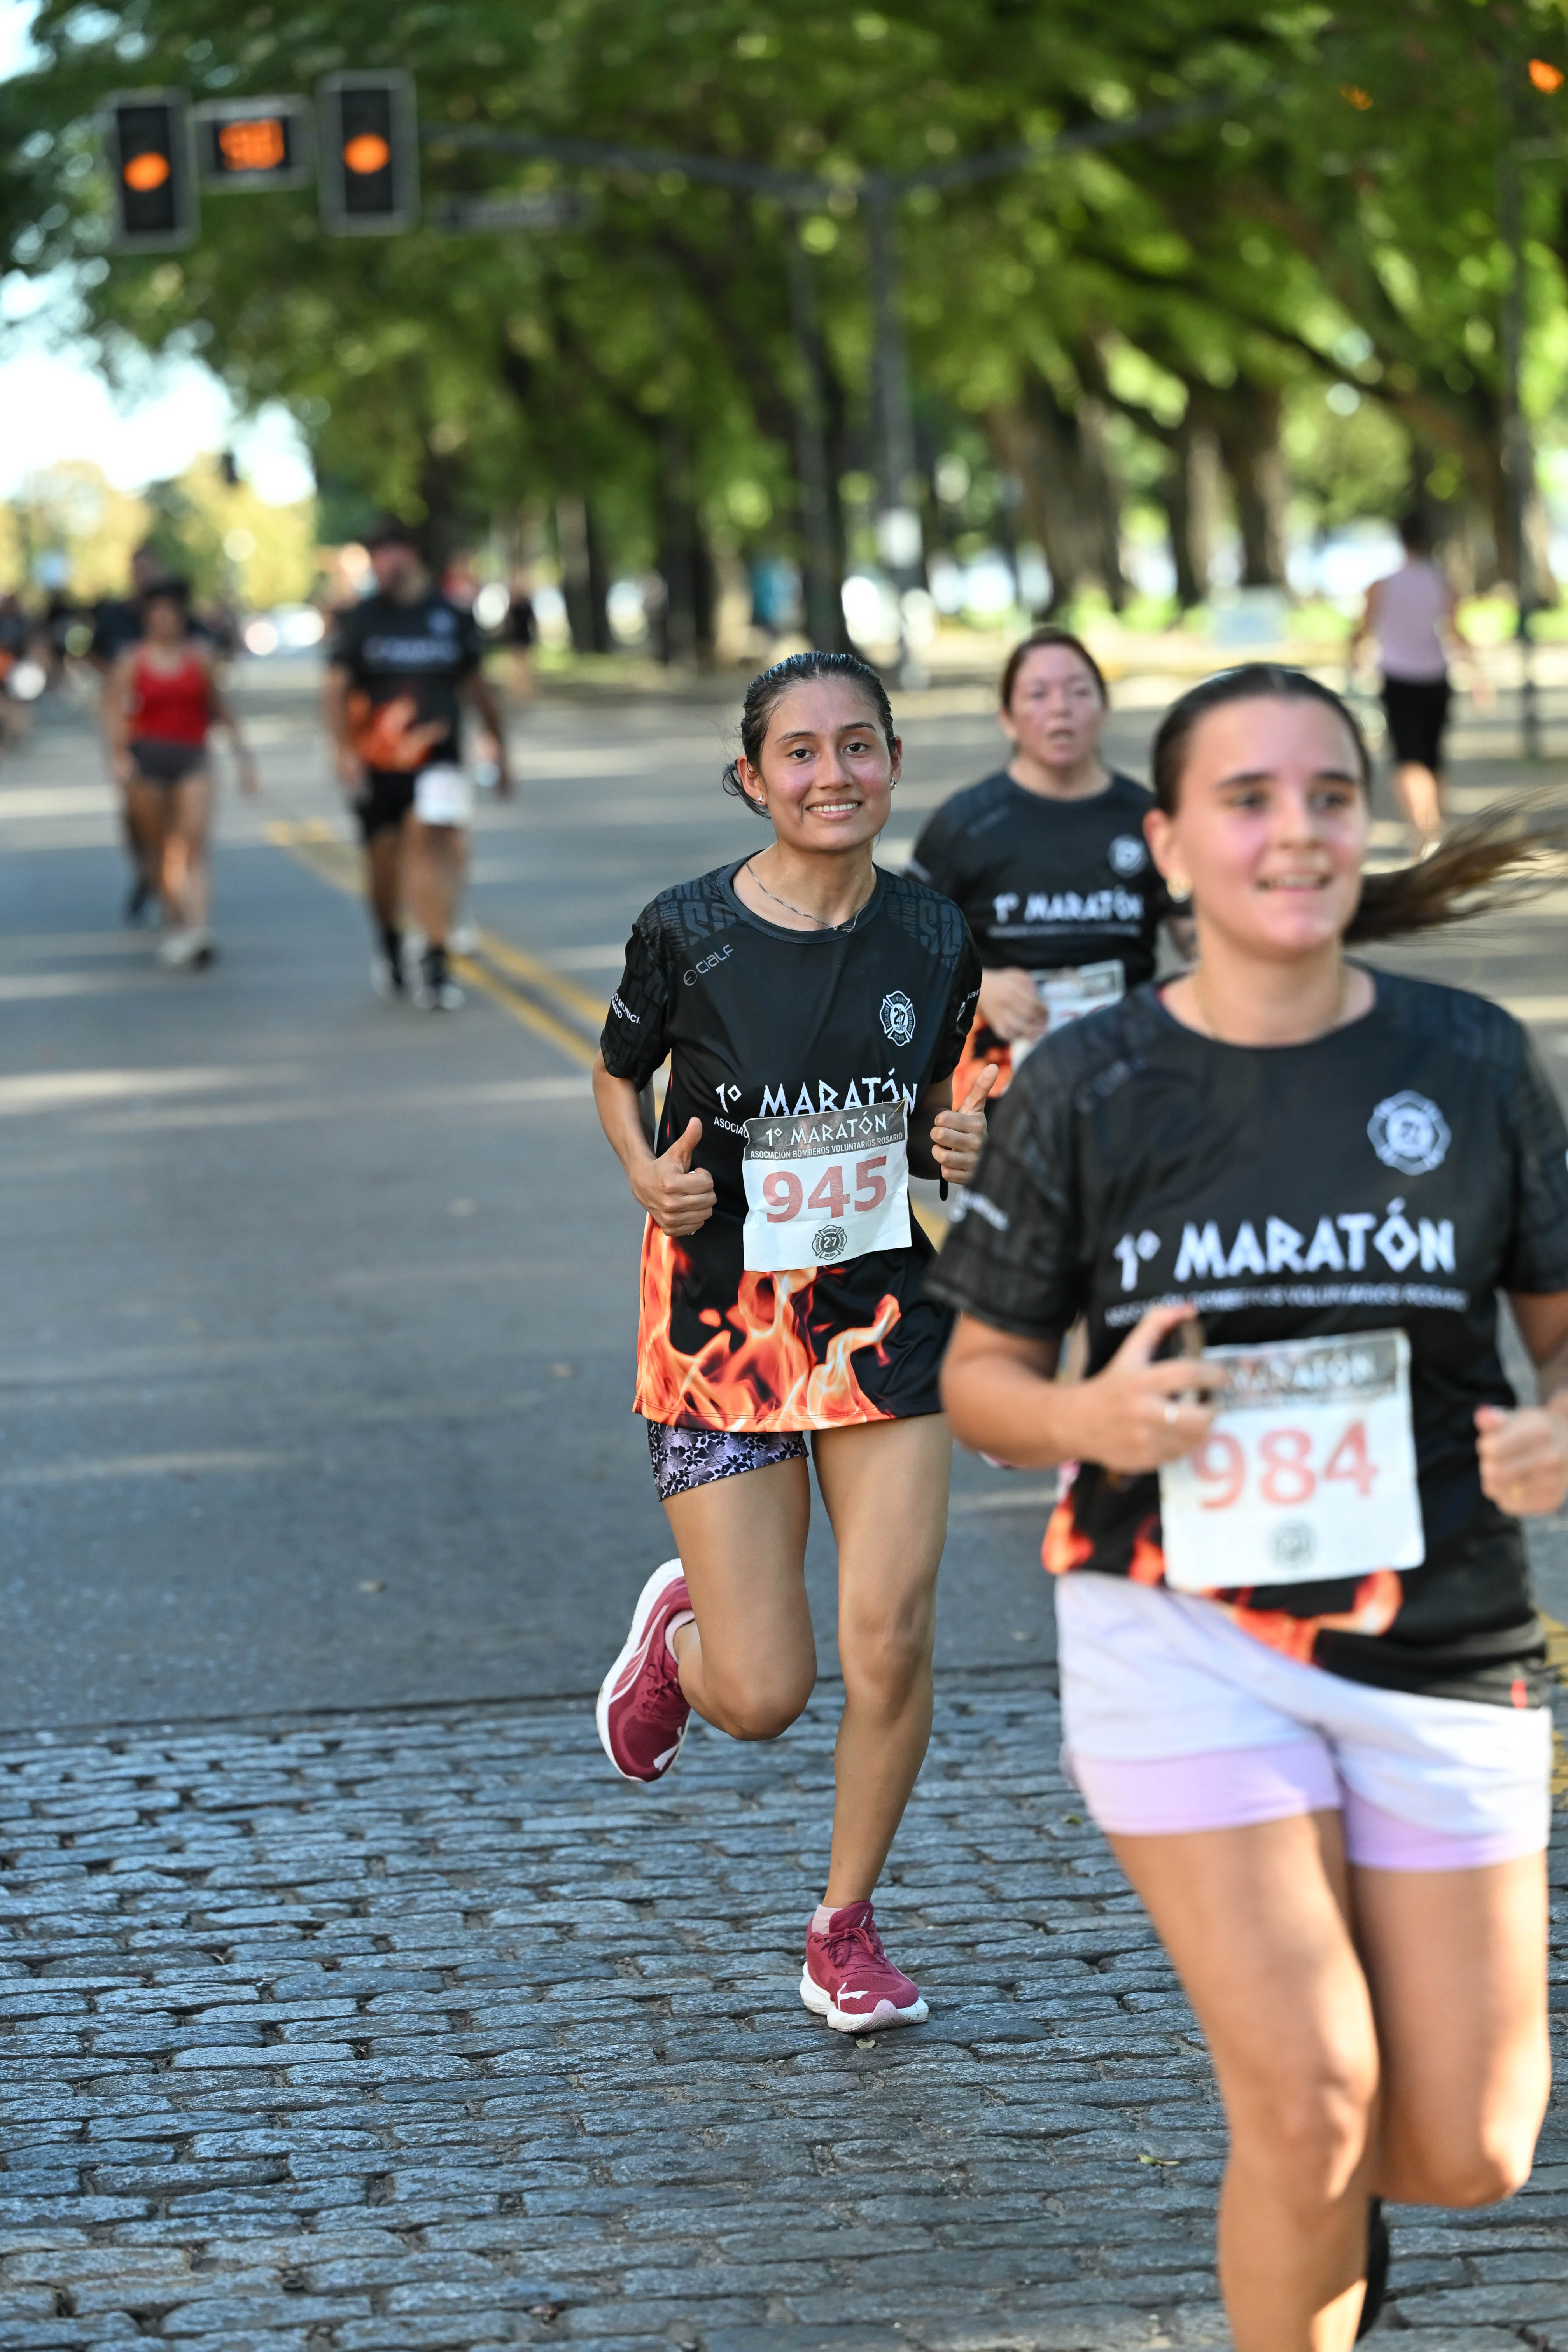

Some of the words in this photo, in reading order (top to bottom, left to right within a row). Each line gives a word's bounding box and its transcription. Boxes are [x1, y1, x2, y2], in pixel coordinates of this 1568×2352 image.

[1024, 884, 1145, 923] MARATÓN
[618, 999, 640, 1024] MUNICI
[759, 1068, 918, 1117] MARATÓN
[750, 1150, 791, 1159] ASOCIACIÓN
[793, 1145, 830, 1157] BOMBEROS
[831, 1141, 876, 1153] VOLUNTARIOS
[877, 1132, 903, 1145] ROSARIO
[790, 1111, 887, 1146] MARATÓN
[763, 1155, 887, 1223] 945
[824, 1237, 837, 1248] 27
[1173, 1196, 1457, 1282] MARATÓN
[1191, 1419, 1379, 1510] 984
